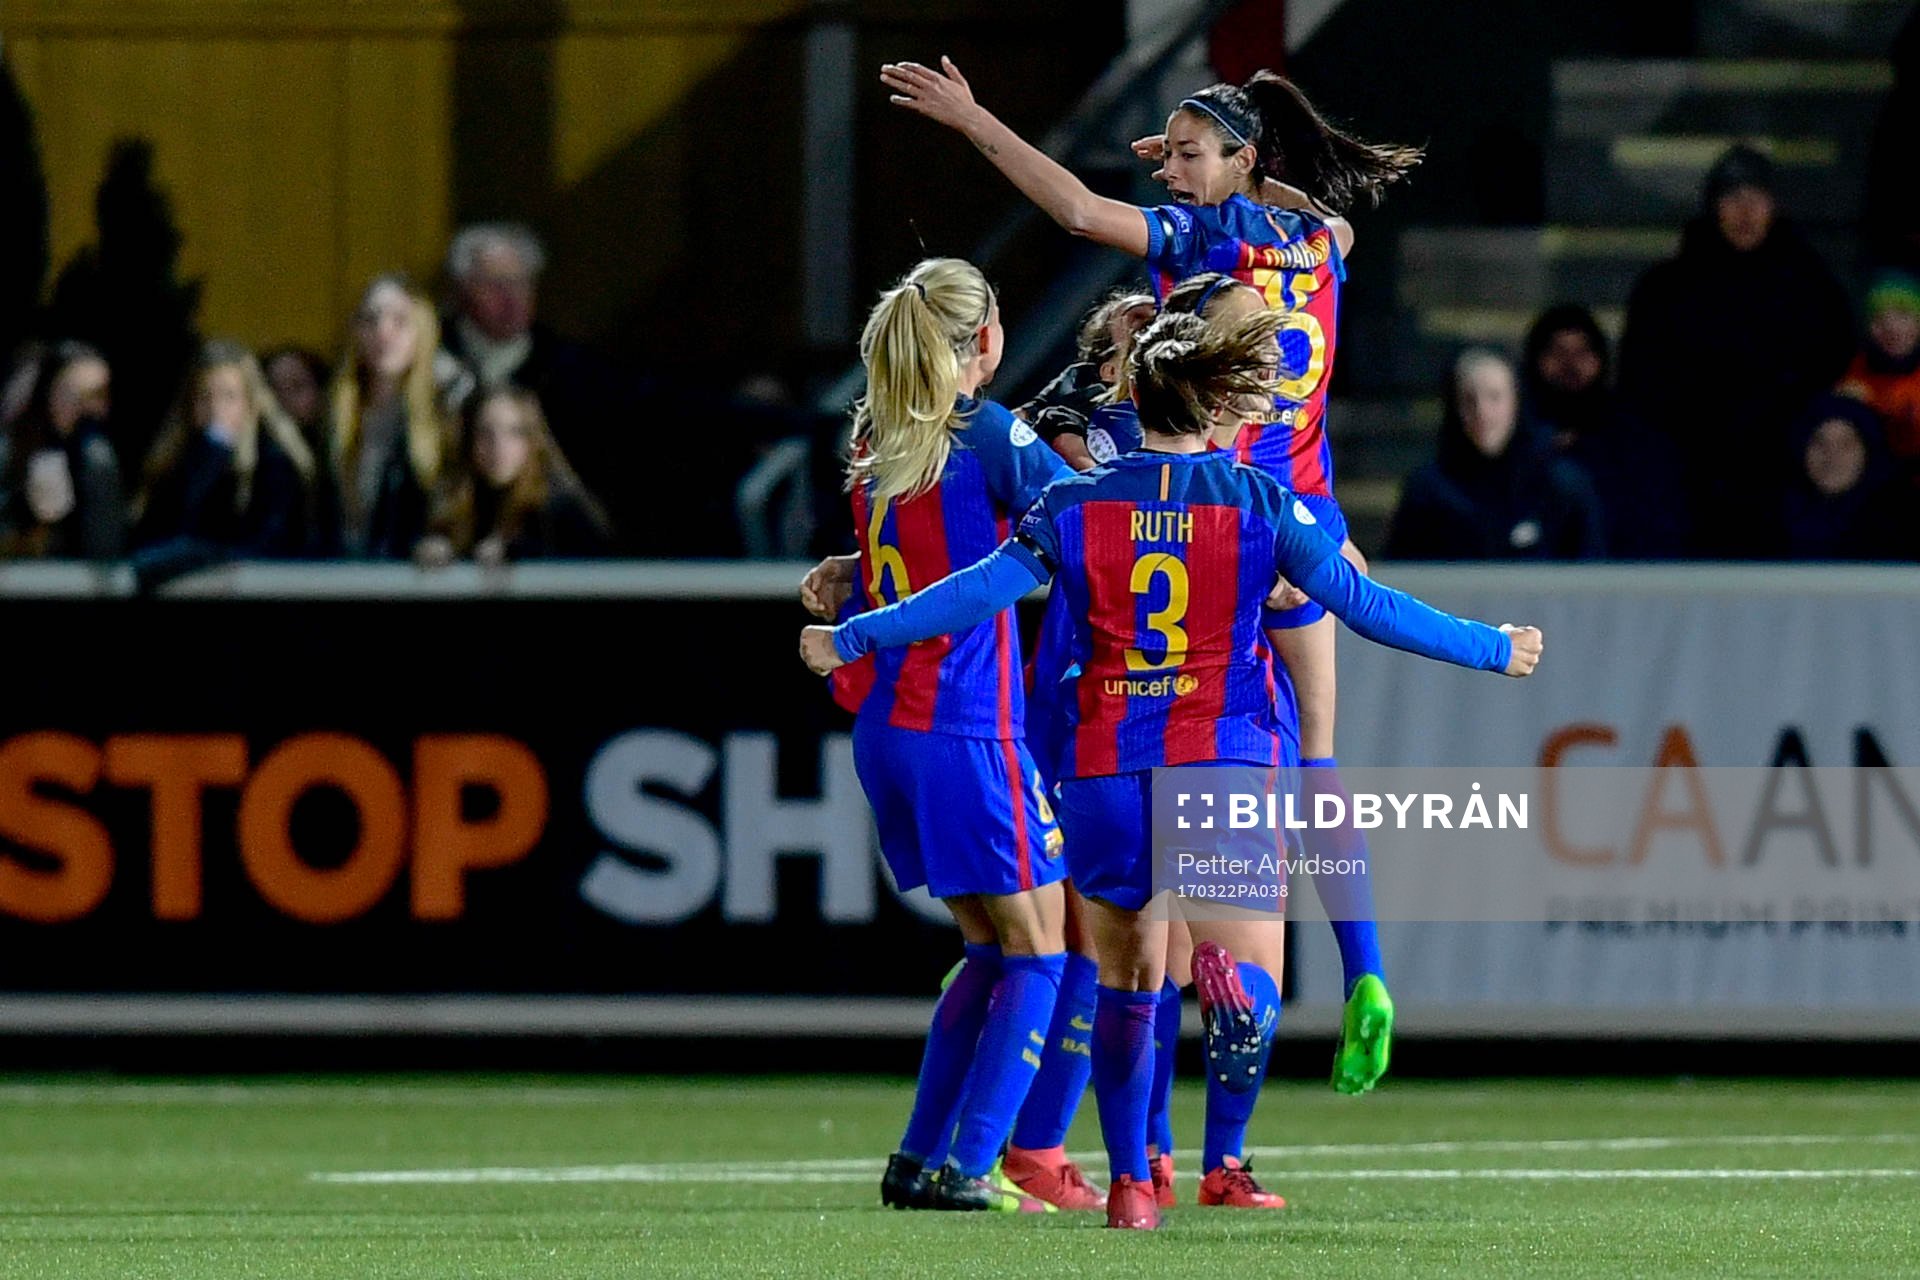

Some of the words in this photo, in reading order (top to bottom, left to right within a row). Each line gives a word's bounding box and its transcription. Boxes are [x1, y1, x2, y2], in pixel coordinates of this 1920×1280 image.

[1130, 510, 1194, 543] RUTH
[1124, 552, 1190, 672] 3
[1104, 675, 1172, 697] unicef
[0, 730, 549, 924] STOP
[579, 727, 960, 927] SH
